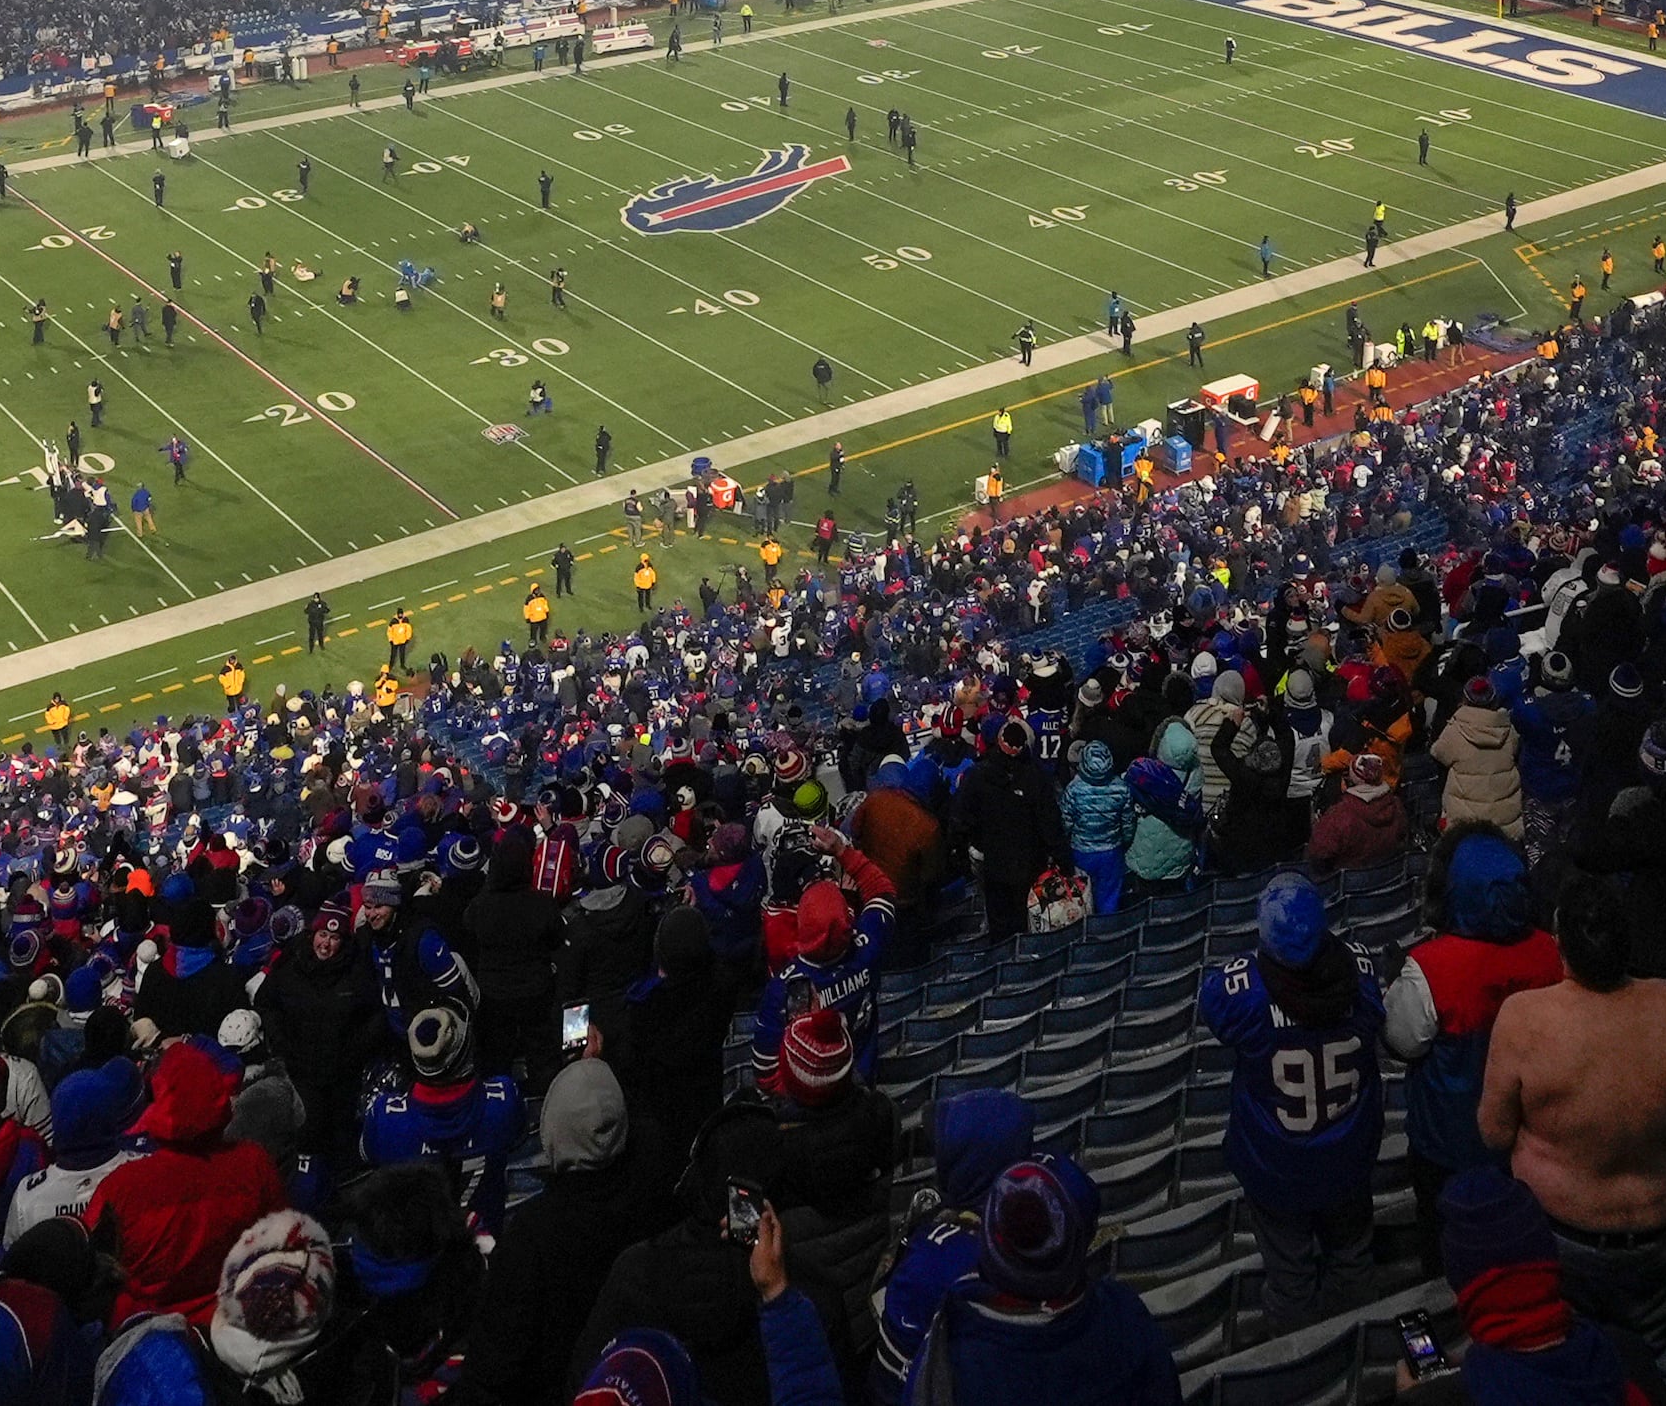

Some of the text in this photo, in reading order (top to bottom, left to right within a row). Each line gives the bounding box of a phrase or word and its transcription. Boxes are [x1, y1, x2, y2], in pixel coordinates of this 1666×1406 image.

[981, 45, 1033, 60] 20
[856, 69, 911, 85] 30
[1415, 108, 1470, 127] 10
[572, 123, 637, 142] 50
[1294, 138, 1351, 159] 20
[412, 154, 471, 174] 40
[1163, 171, 1225, 192] 30
[234, 188, 306, 211] 30
[1028, 205, 1086, 229] 40
[41, 225, 117, 250] 20
[860, 245, 933, 271] 50
[692, 288, 761, 316] 40
[490, 336, 572, 368] 30
[265, 390, 358, 427] 20
[724, 490, 733, 504] G
[1039, 732, 1063, 761] 17
[1555, 736, 1574, 767] 4
[1345, 941, 1374, 980] 95
[1222, 958, 1249, 995] 95
[819, 969, 871, 1010] WILLIAMS
[1269, 1036, 1362, 1132] 95
[460, 1156, 487, 1208] 7
[926, 1222, 960, 1246] 17
